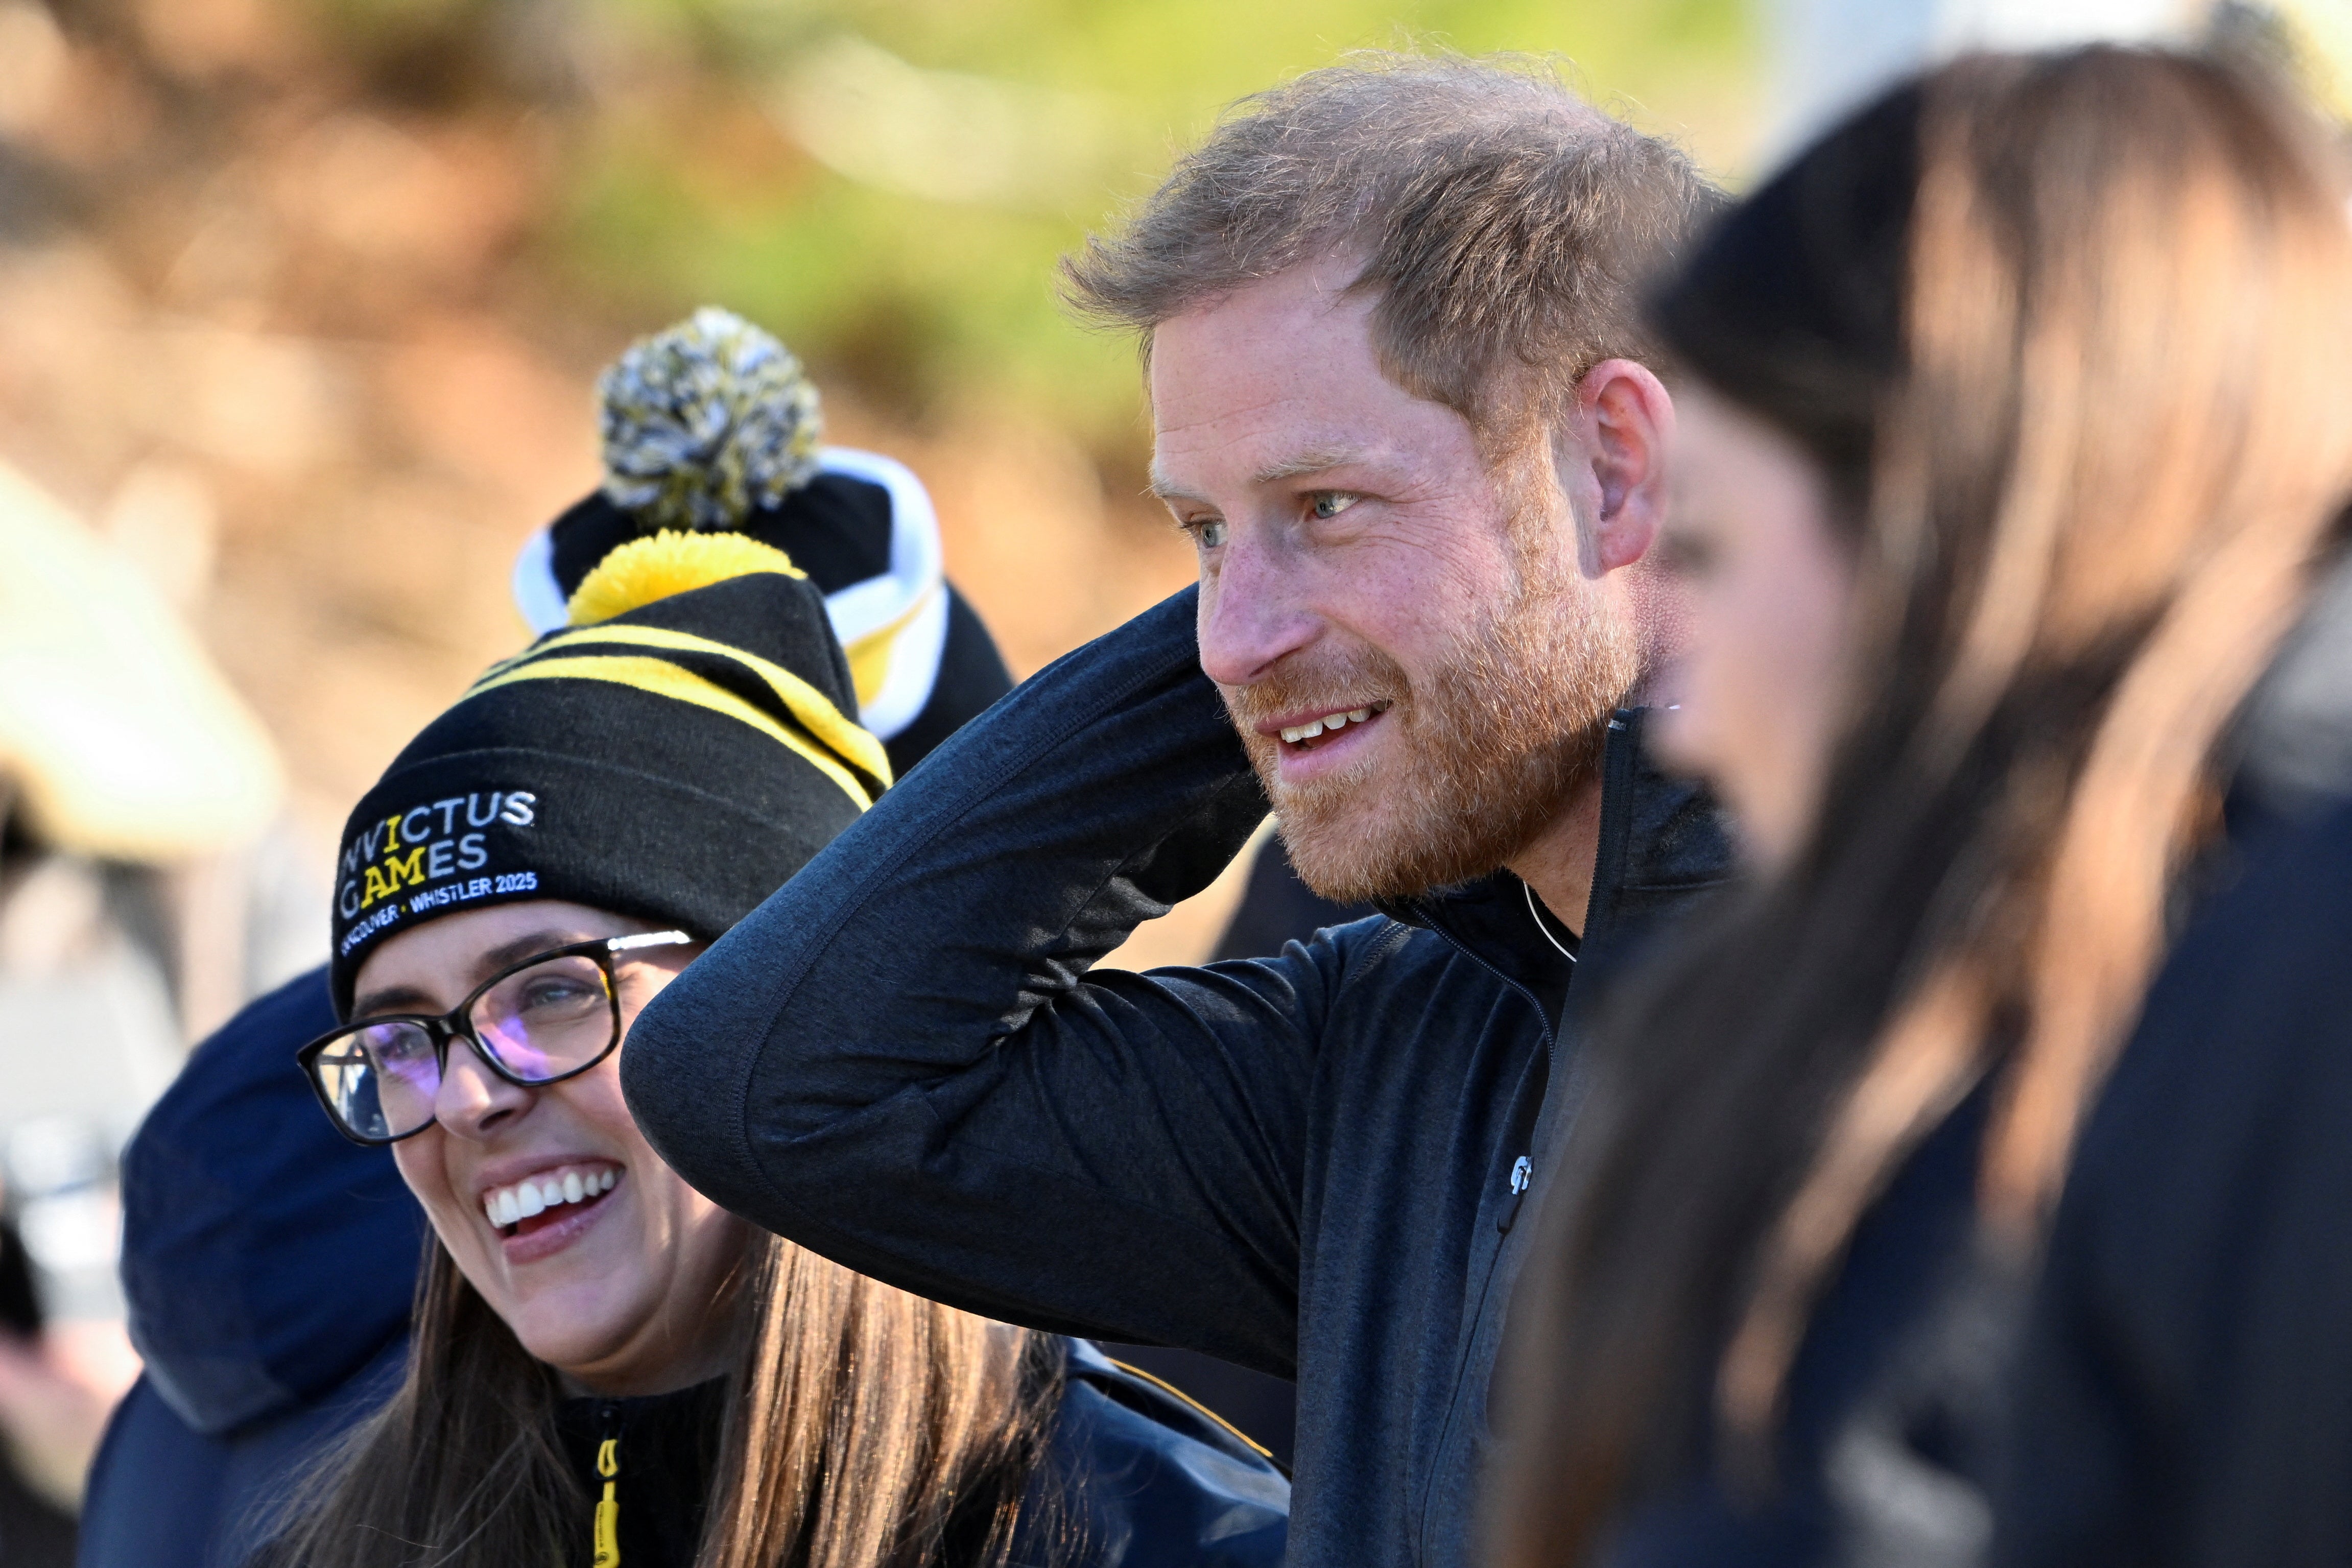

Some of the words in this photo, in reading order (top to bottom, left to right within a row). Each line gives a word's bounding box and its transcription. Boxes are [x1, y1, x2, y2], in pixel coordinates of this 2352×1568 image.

[337, 791, 536, 877] NVICTUS
[340, 833, 488, 920] GAMES
[409, 877, 493, 914] WHISTLER
[495, 871, 539, 893] 2025
